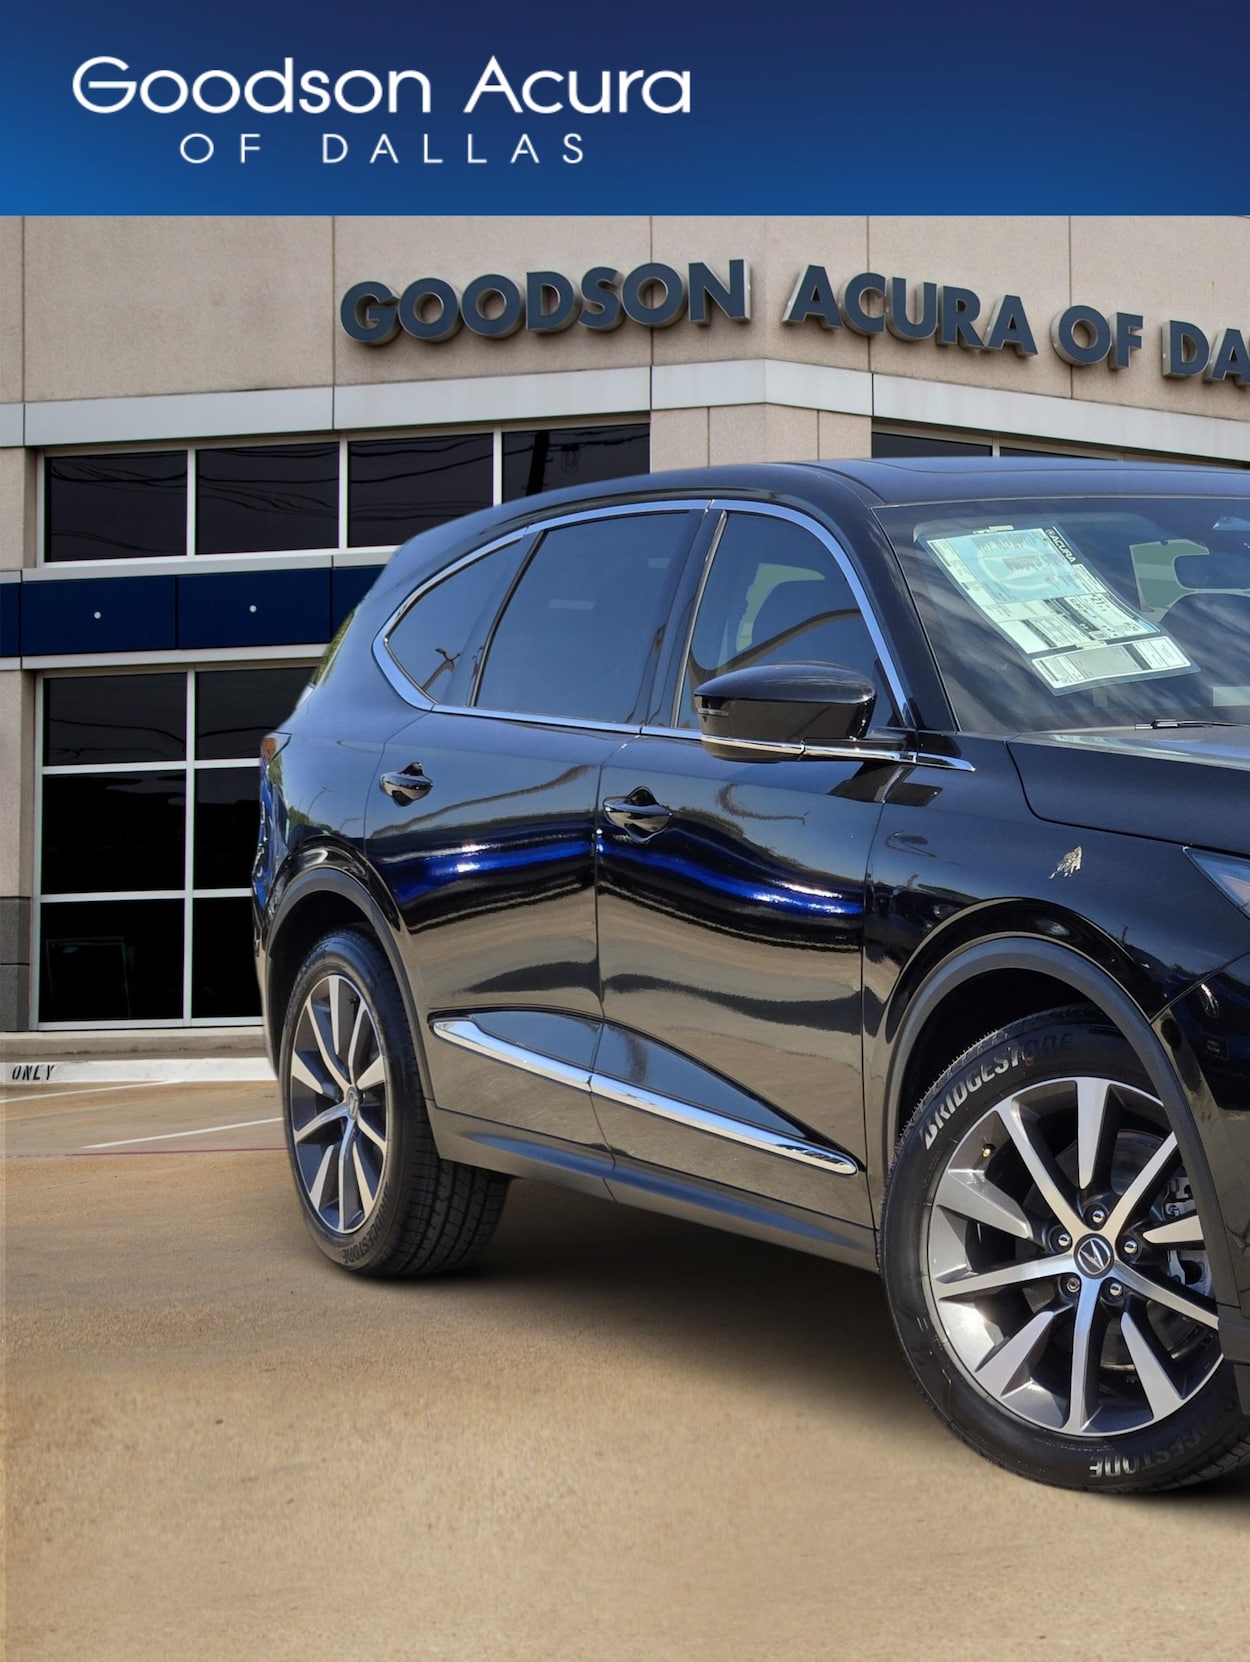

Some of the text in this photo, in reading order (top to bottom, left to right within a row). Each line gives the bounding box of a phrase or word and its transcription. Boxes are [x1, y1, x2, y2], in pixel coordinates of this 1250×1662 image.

[340, 259, 751, 346] GOODSON
[783, 264, 1038, 357] ACURA
[1051, 304, 1144, 369] OF
[1050, 535, 1076, 563] ACURA
[12, 1064, 55, 1081] ONLY
